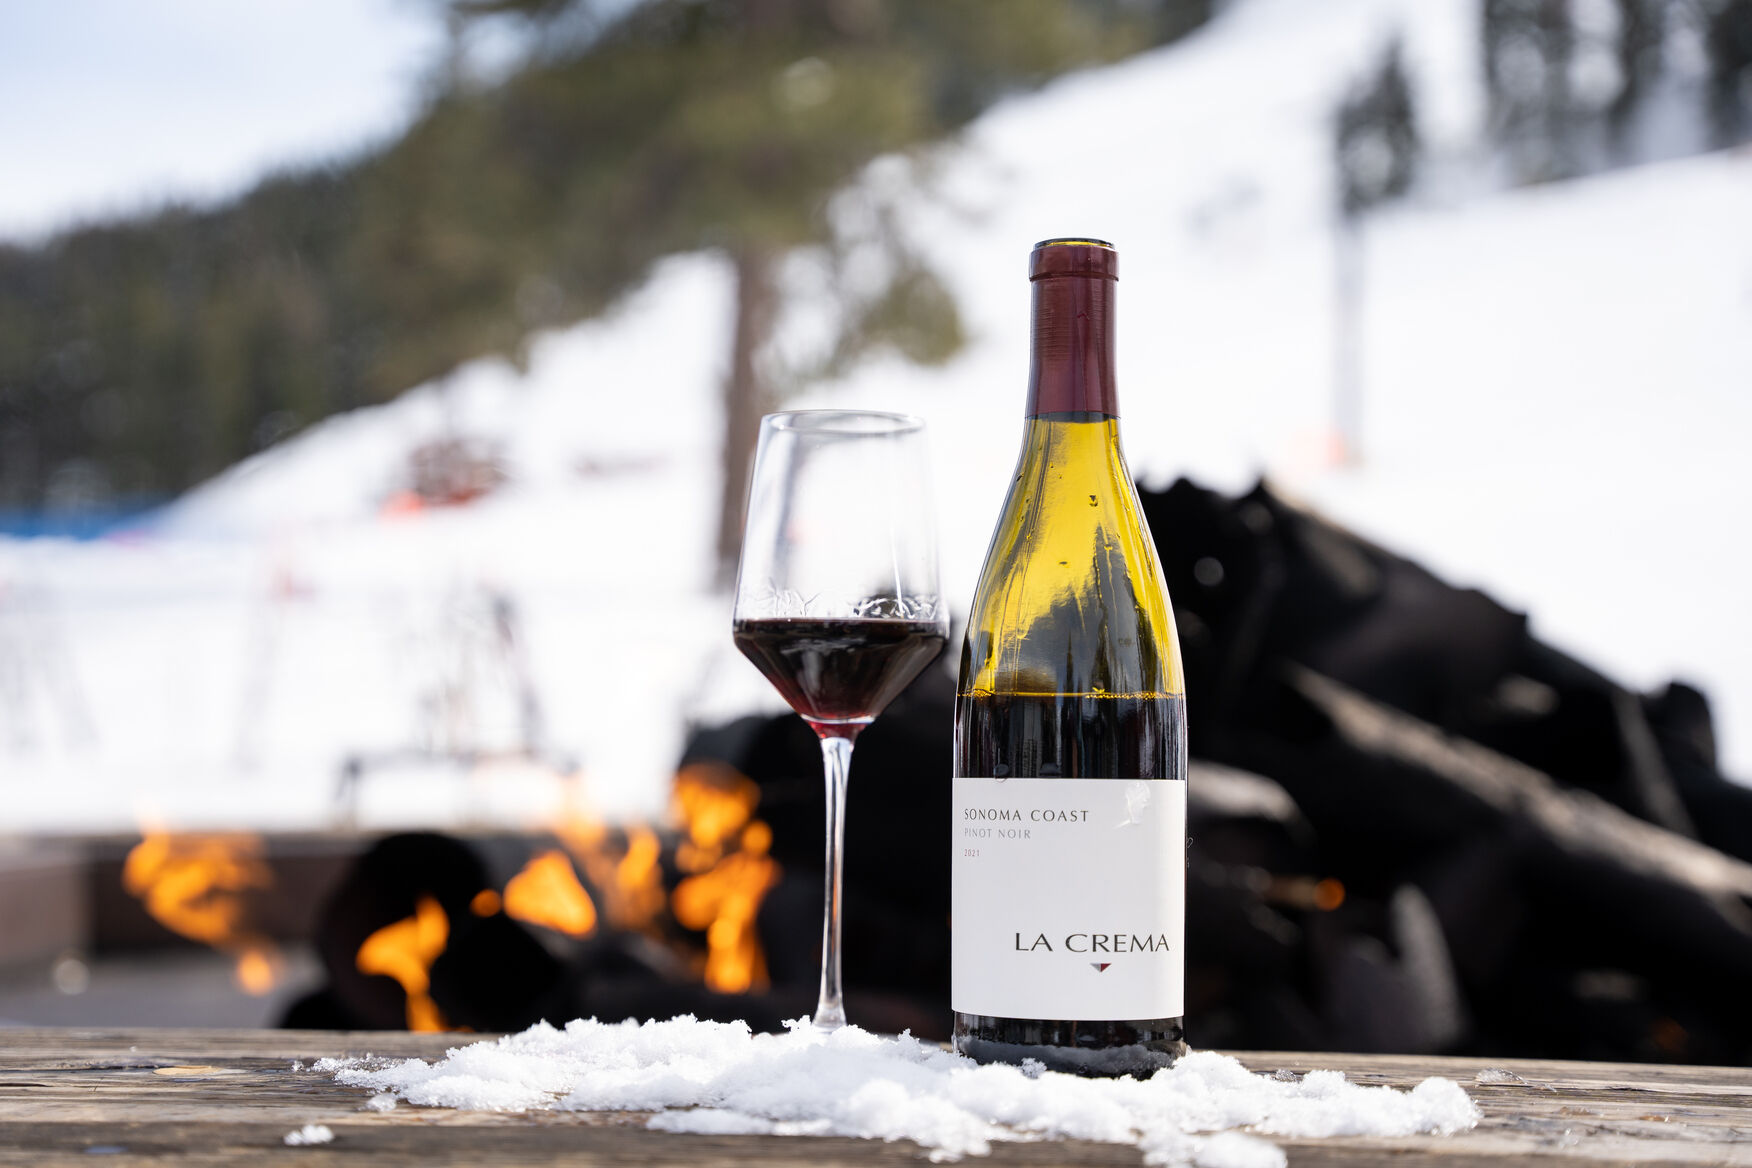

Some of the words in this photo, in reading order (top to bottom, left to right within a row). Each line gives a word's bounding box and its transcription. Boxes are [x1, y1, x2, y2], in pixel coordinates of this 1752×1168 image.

[964, 808, 1022, 821] SONOMA
[1030, 809, 1089, 822] COAST
[964, 827, 992, 838] PINOT
[998, 829, 1031, 839] NOIR
[964, 848, 980, 857] 2021
[1015, 932, 1053, 951] LA
[1065, 933, 1170, 952] CREMA
